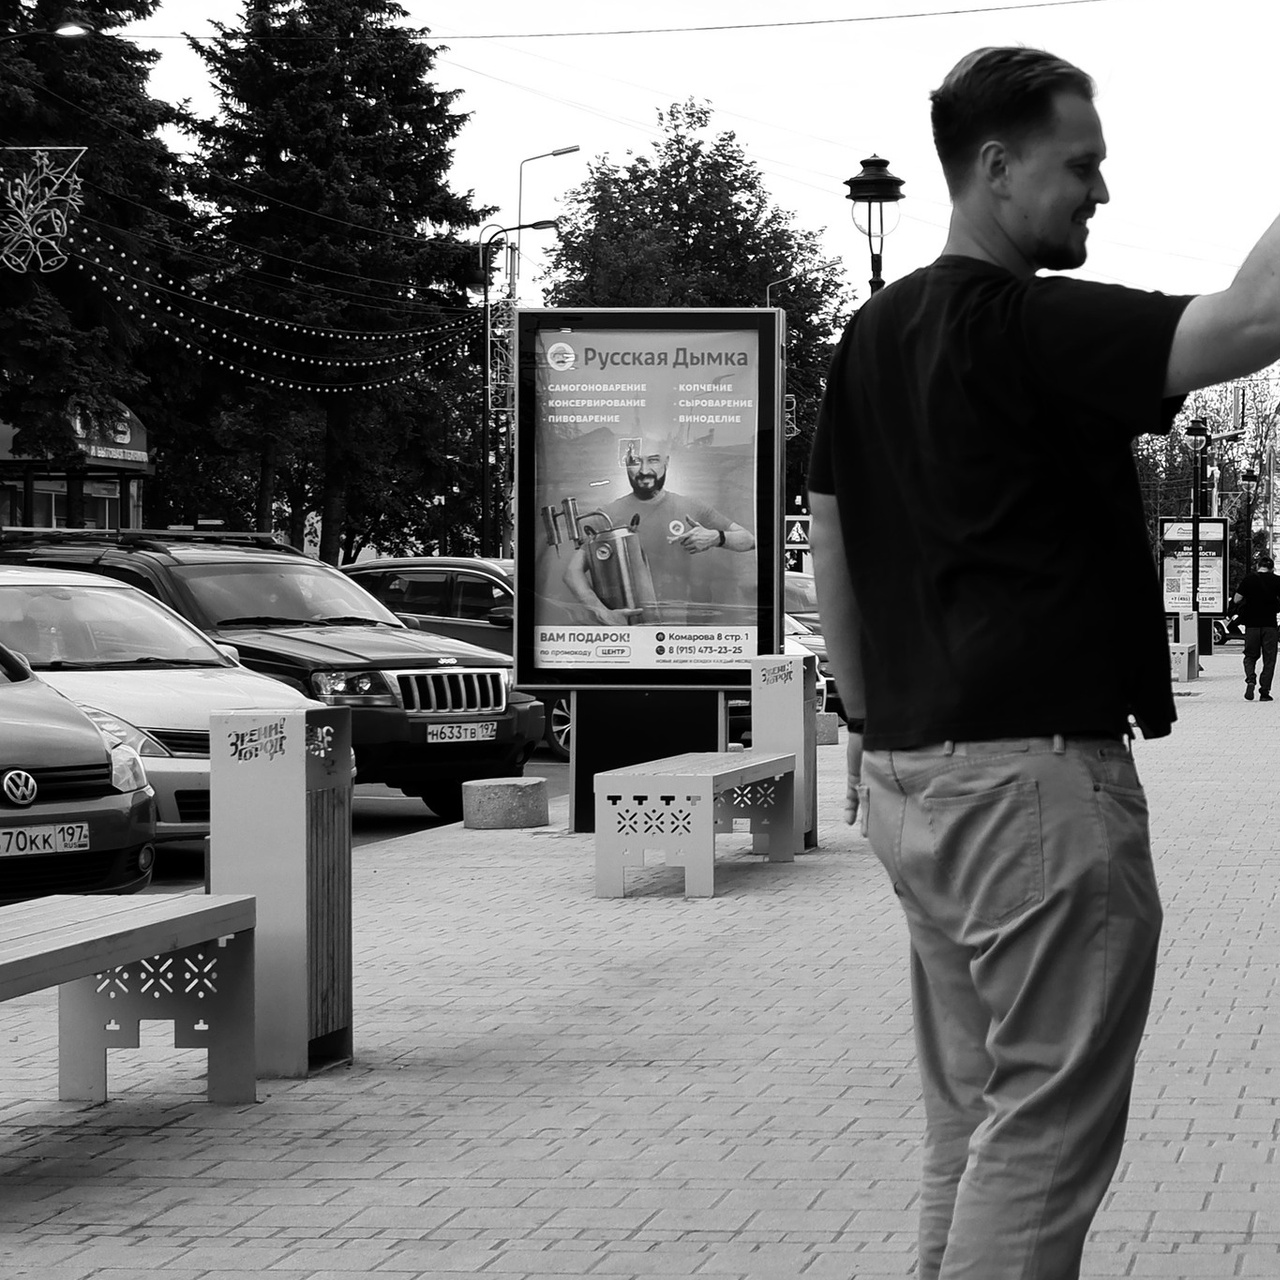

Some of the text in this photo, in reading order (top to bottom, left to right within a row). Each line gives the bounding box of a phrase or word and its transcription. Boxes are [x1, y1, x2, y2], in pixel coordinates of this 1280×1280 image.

[584, 347, 748, 370] Русская Дымка
[548, 383, 647, 392] САМОГОНОВАРЕНИЕ
[678, 384, 733, 392] КОПЧЕНИЕ
[548, 399, 646, 407] КОНСЕРВИРОВАНИЕ
[678, 399, 753, 408] СЫРОВАРЕНИЕ
[548, 414, 620, 423] ПИВОВАРЕНИЕ
[678, 414, 742, 424] ВИНОДЕЛИЕ
[540, 632, 630, 644] ВАМ ПОДАРОК!
[668, 633, 715, 642] Комарова
[724, 634, 743, 642] стр.
[668, 645, 743, 654] 8 (915) 473-23-25
[0, 825, 84, 853] 70КК 197
